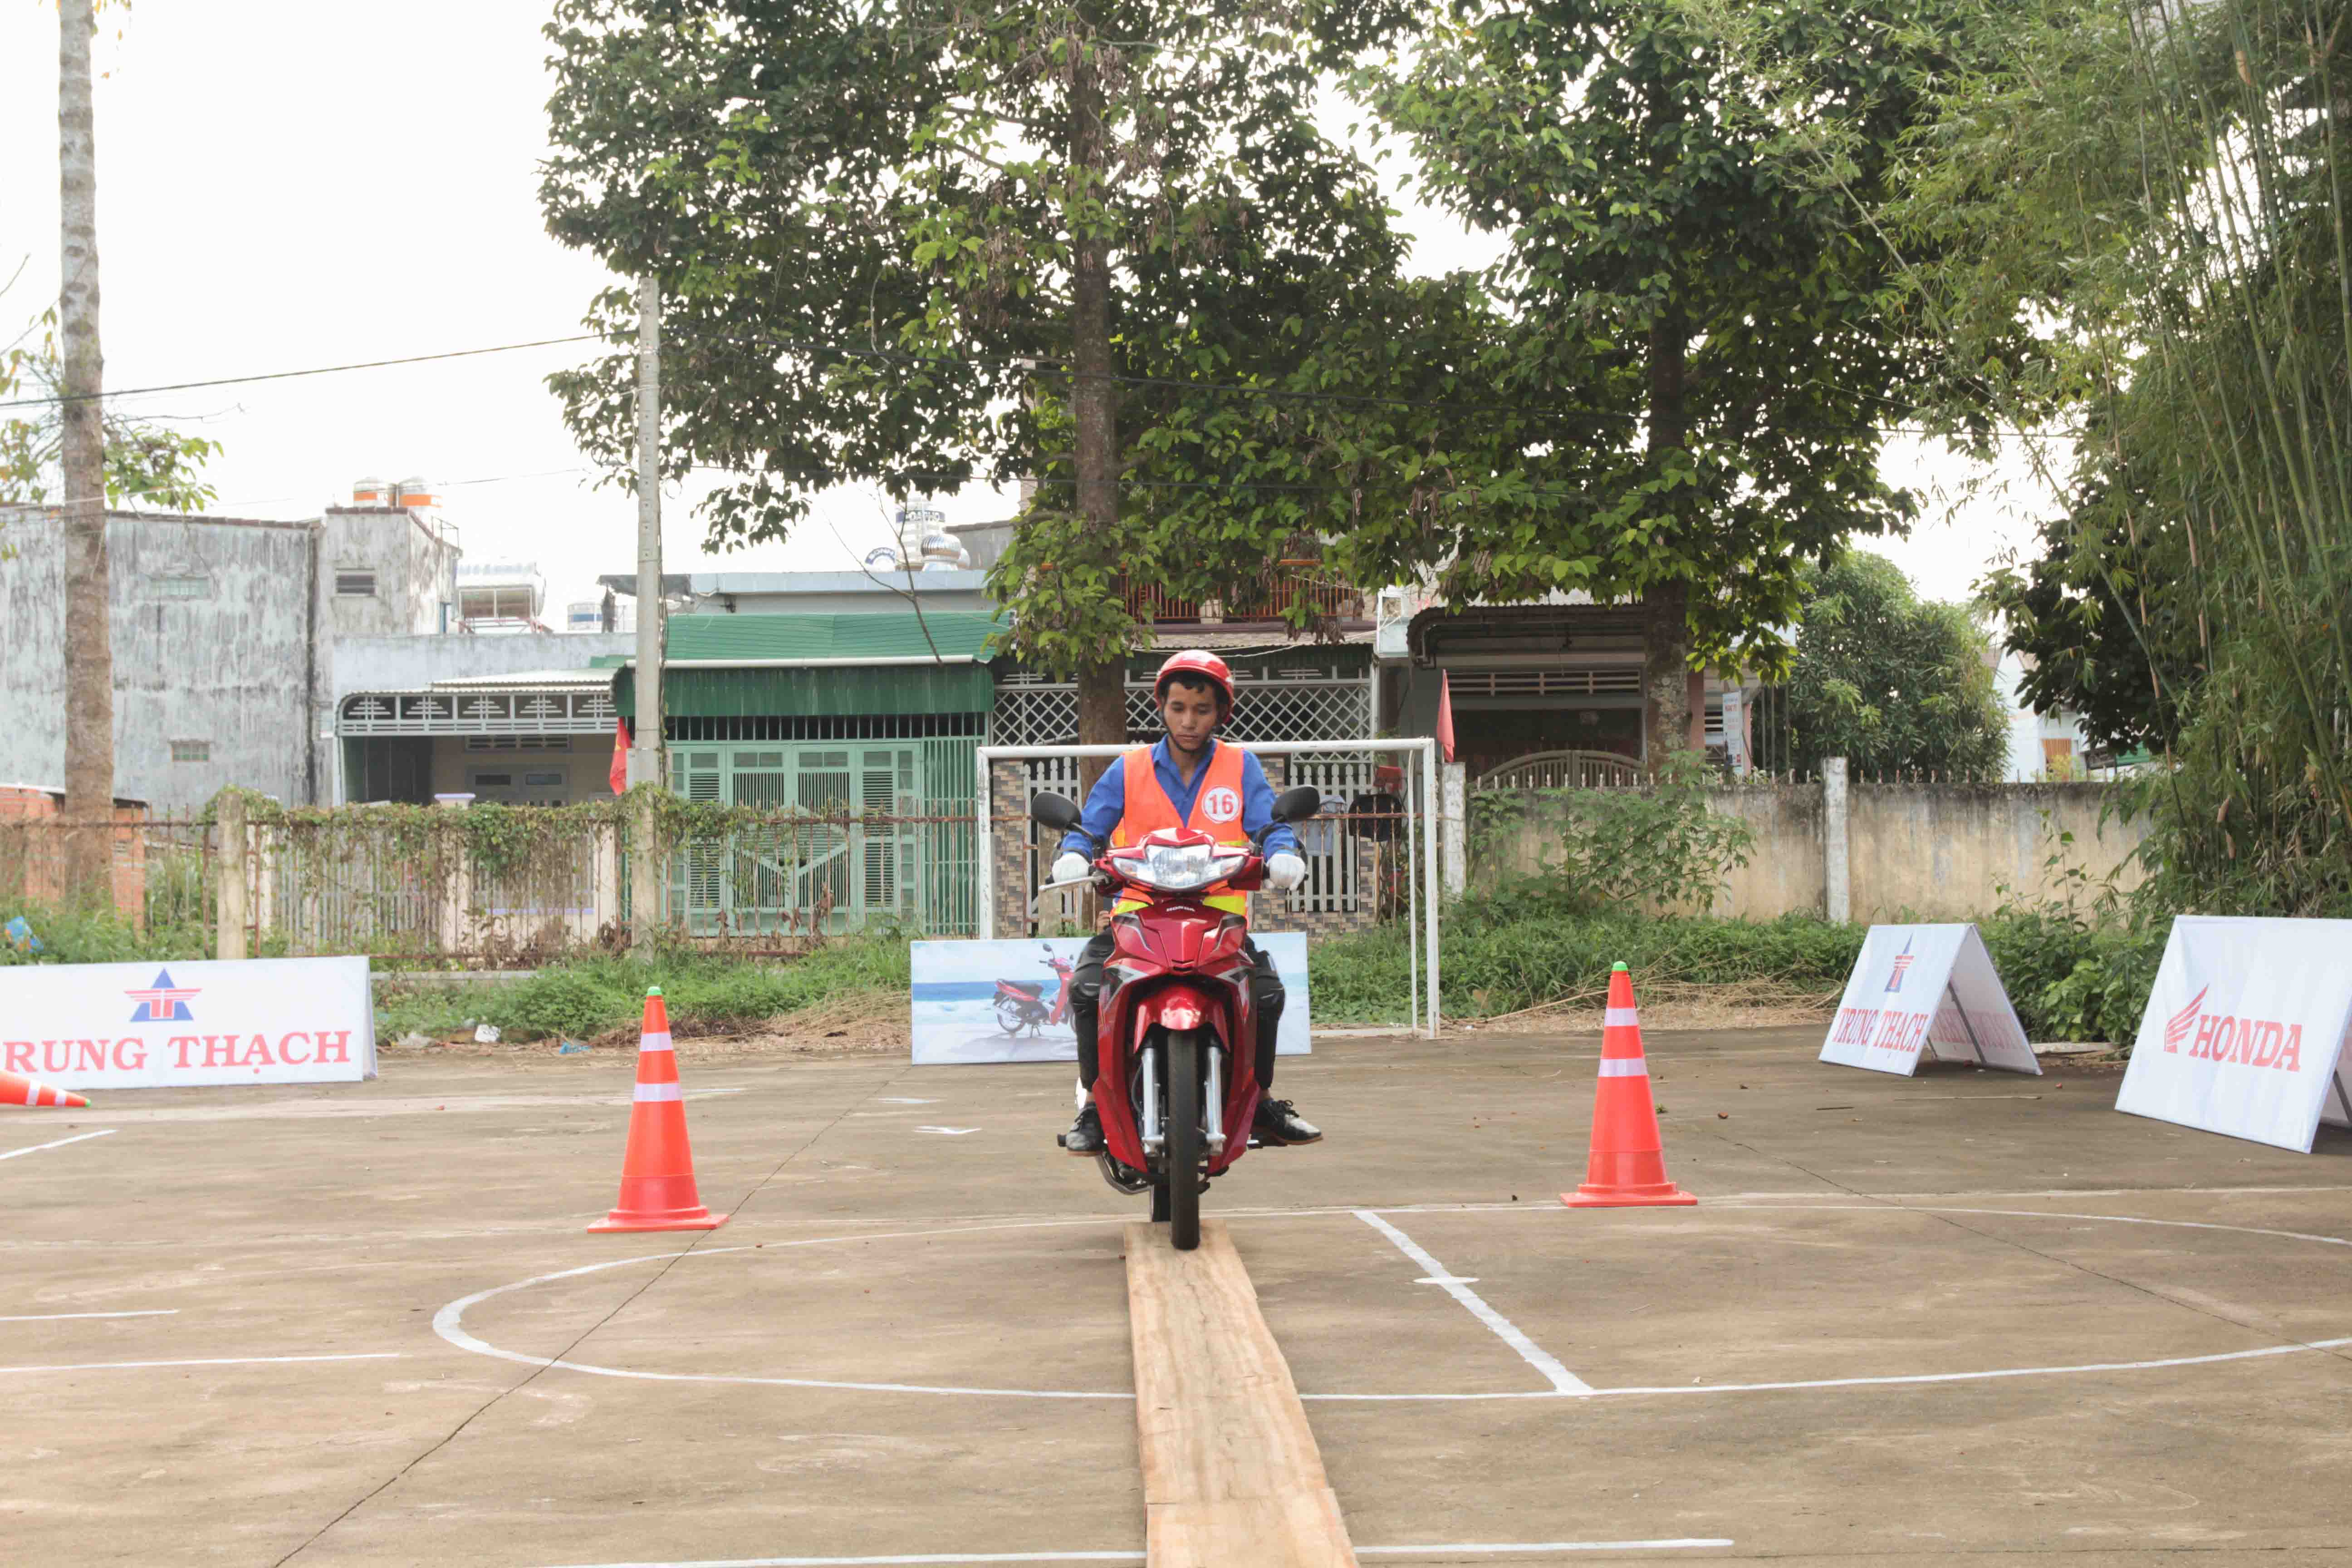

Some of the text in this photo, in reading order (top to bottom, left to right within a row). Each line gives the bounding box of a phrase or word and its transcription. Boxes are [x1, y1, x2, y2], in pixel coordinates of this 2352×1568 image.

[1210, 794, 1234, 814] 16
[1832, 1008, 1880, 1045] TRUNG
[2189, 1014, 2303, 1072] HONDA
[0, 1030, 352, 1074] RUNG THẠCH
